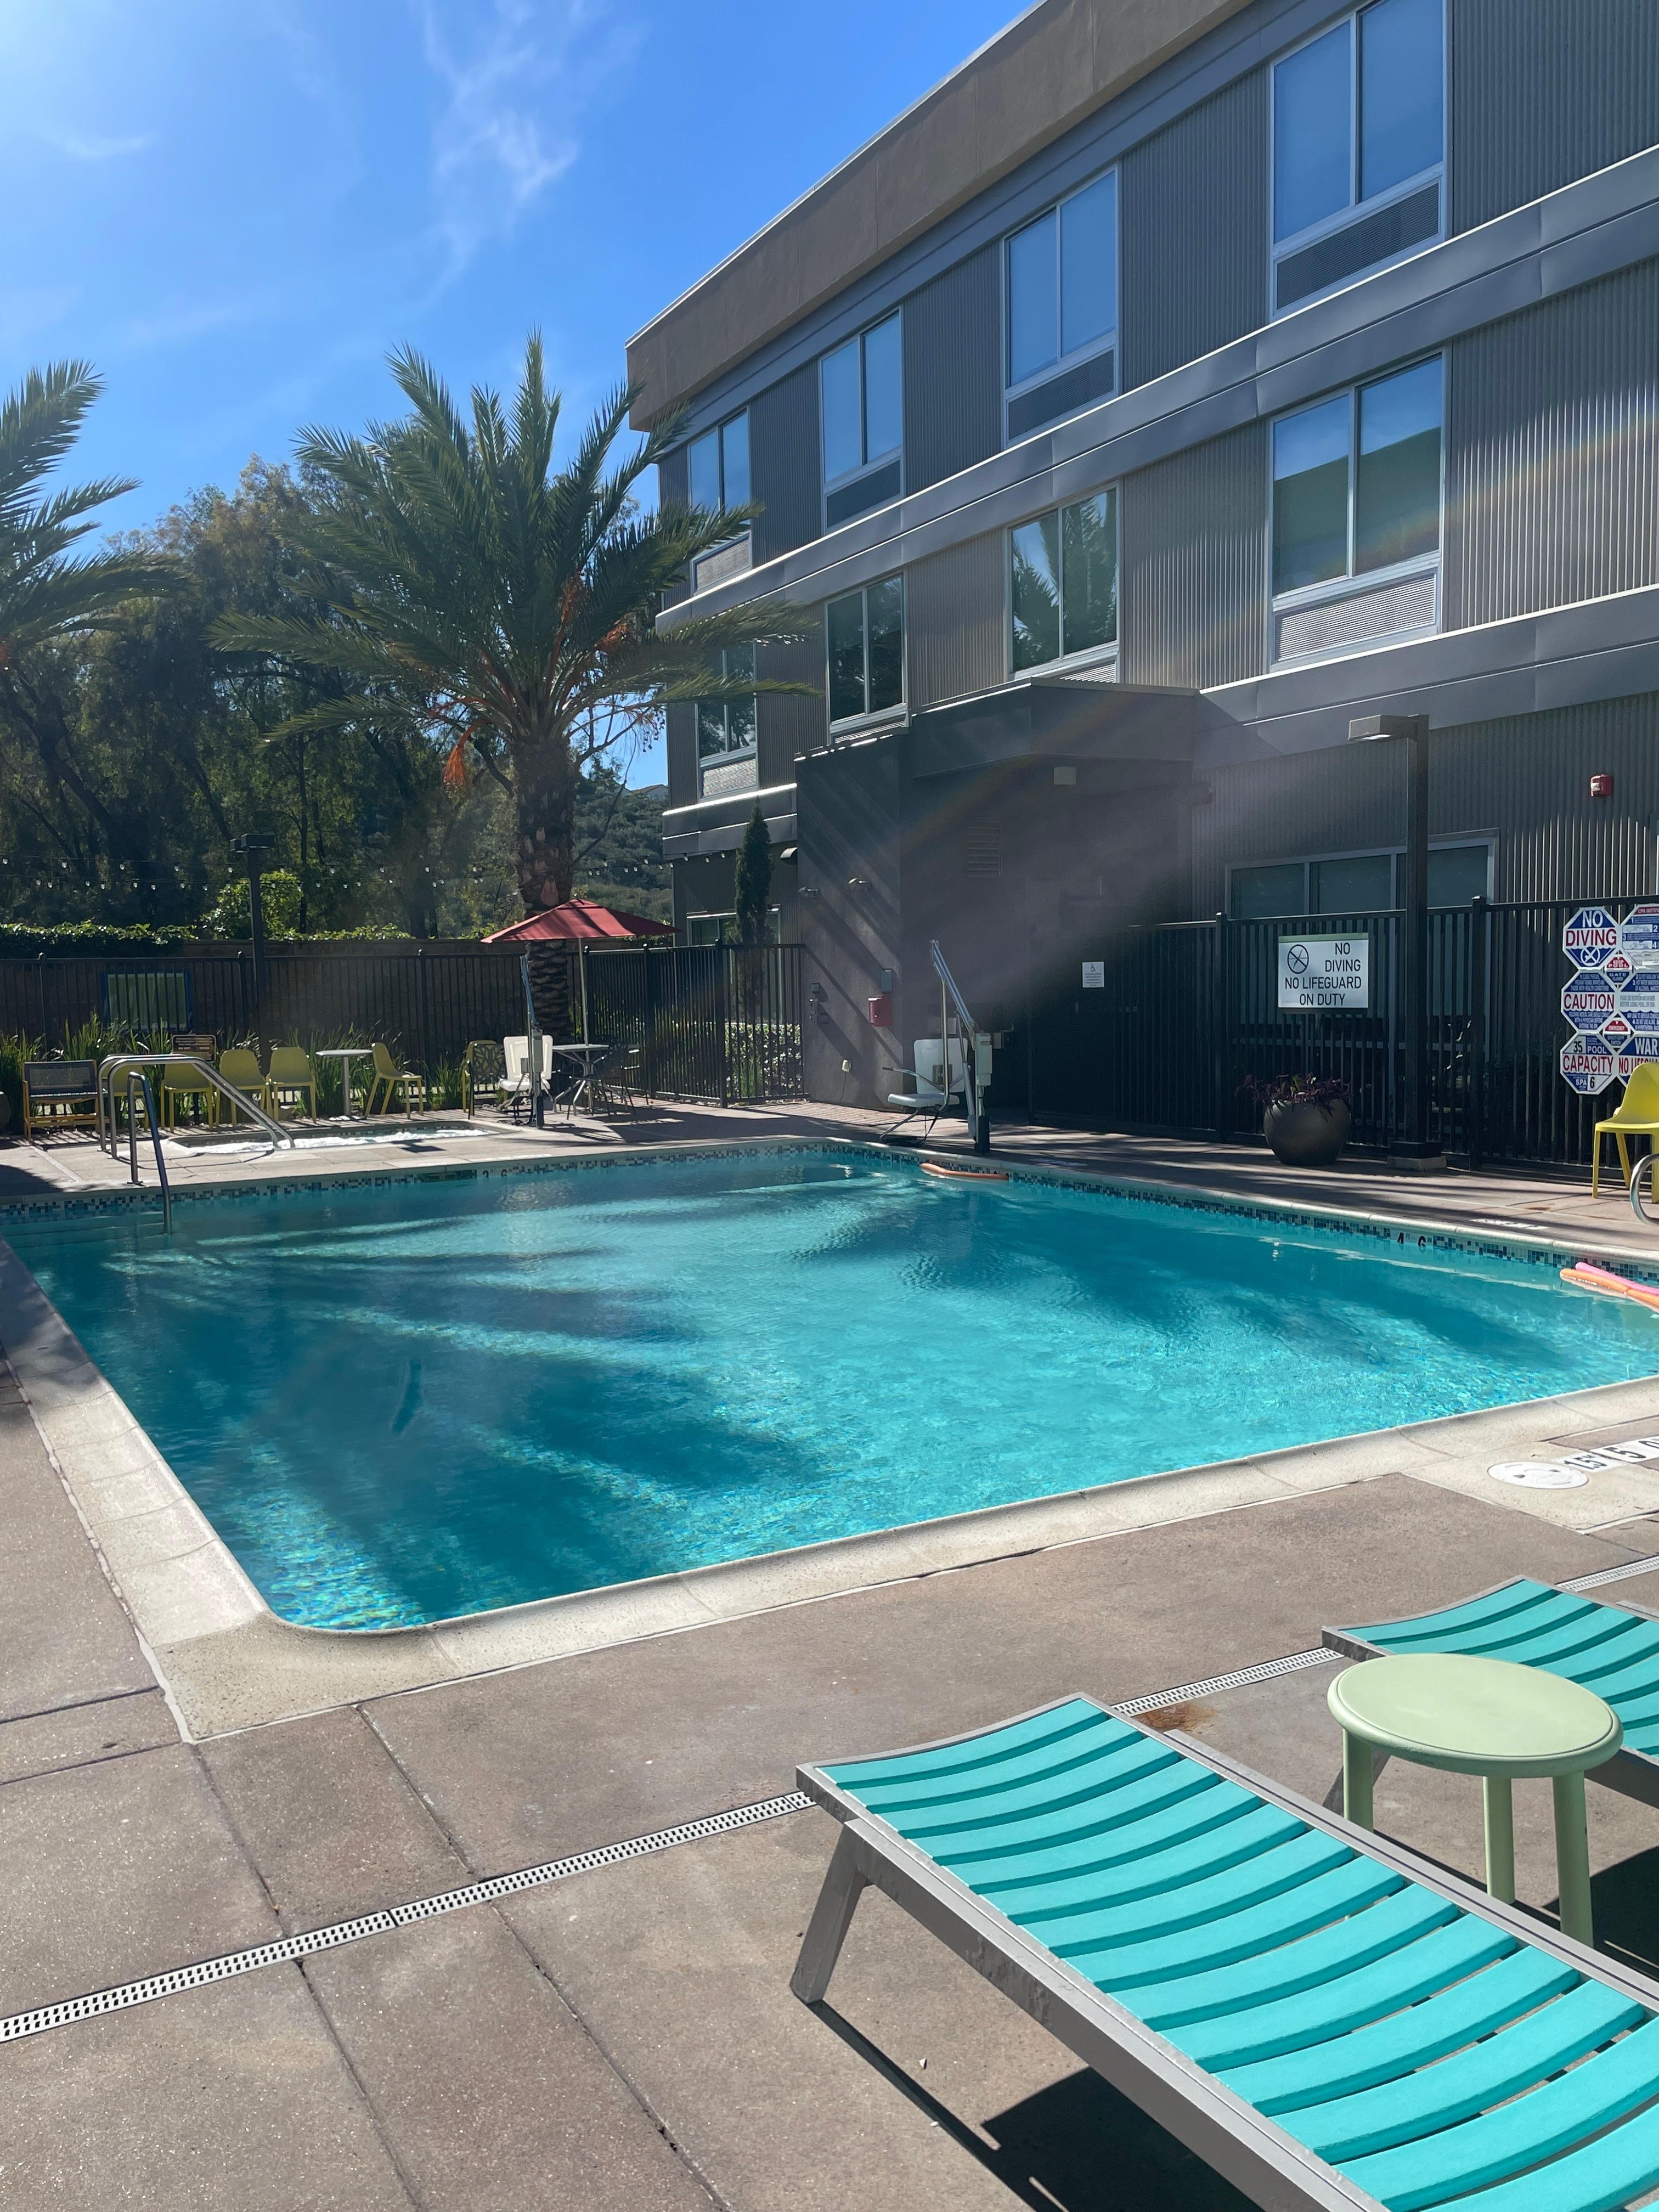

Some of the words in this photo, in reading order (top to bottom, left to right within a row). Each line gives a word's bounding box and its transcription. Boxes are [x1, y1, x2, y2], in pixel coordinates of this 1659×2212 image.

[1582, 910, 1603, 928] NO
[1566, 928, 1617, 946] DIVING
[1335, 943, 1350, 955] NO
[1325, 959, 1361, 972] DIVING
[1285, 977, 1299, 989] NO
[1302, 976, 1362, 989] LIFEGUARD
[1300, 993, 1313, 1006] ON
[1318, 993, 1346, 1006] DUTY
[1564, 994, 1615, 1009] CAUTION
[1573, 1041, 1583, 1053] 35
[1635, 1038, 1659, 1056] WAR
[1563, 1055, 1613, 1073] CAPACITY
[1619, 1057, 1629, 1074] NO
[1590, 1076, 1595, 1088] 6
